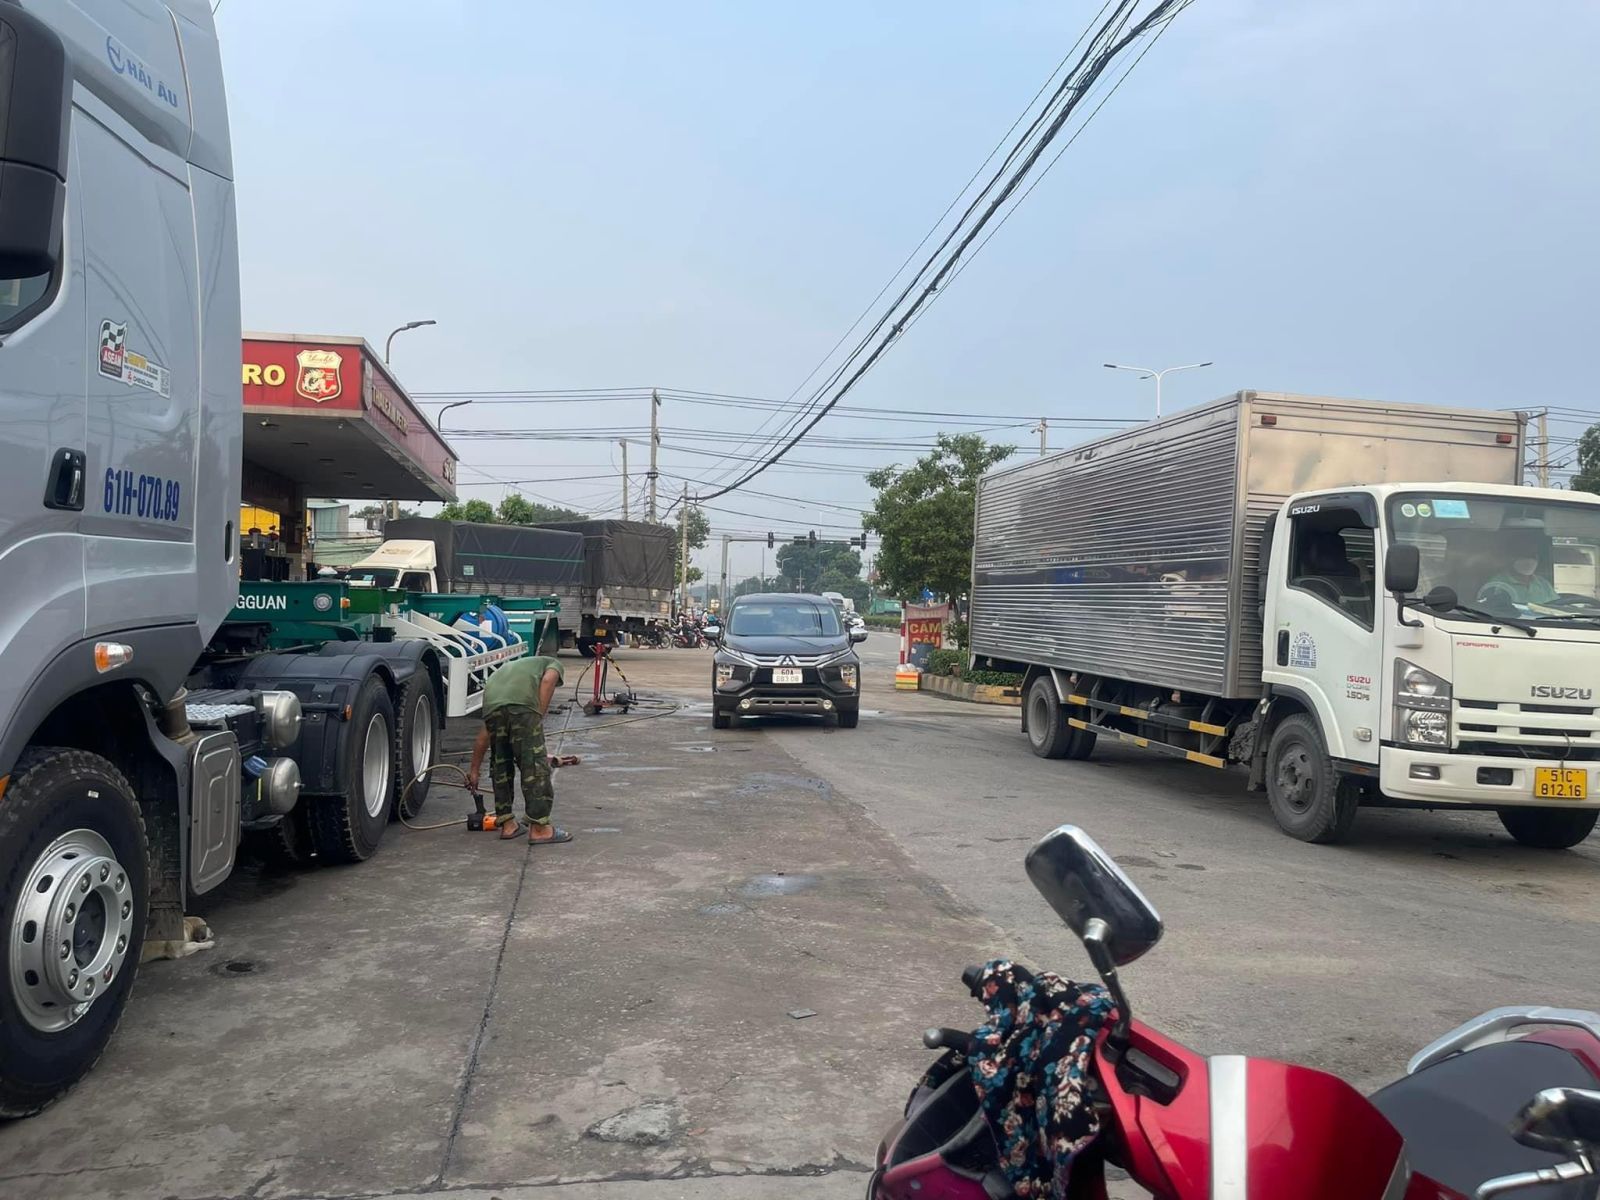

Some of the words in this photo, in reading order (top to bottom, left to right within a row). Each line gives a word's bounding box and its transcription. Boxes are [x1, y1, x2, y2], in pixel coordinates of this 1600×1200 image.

[126, 59, 153, 91] HẢI
[158, 80, 178, 108] ÂU
[103, 467, 180, 521] 61H-070.89
[1292, 504, 1320, 515] ISUZU
[1346, 675, 1371, 685] ISUZU
[1531, 685, 1592, 700] ISUZU
[1551, 769, 1573, 783] 51C
[1541, 783, 1581, 797] 812.16
